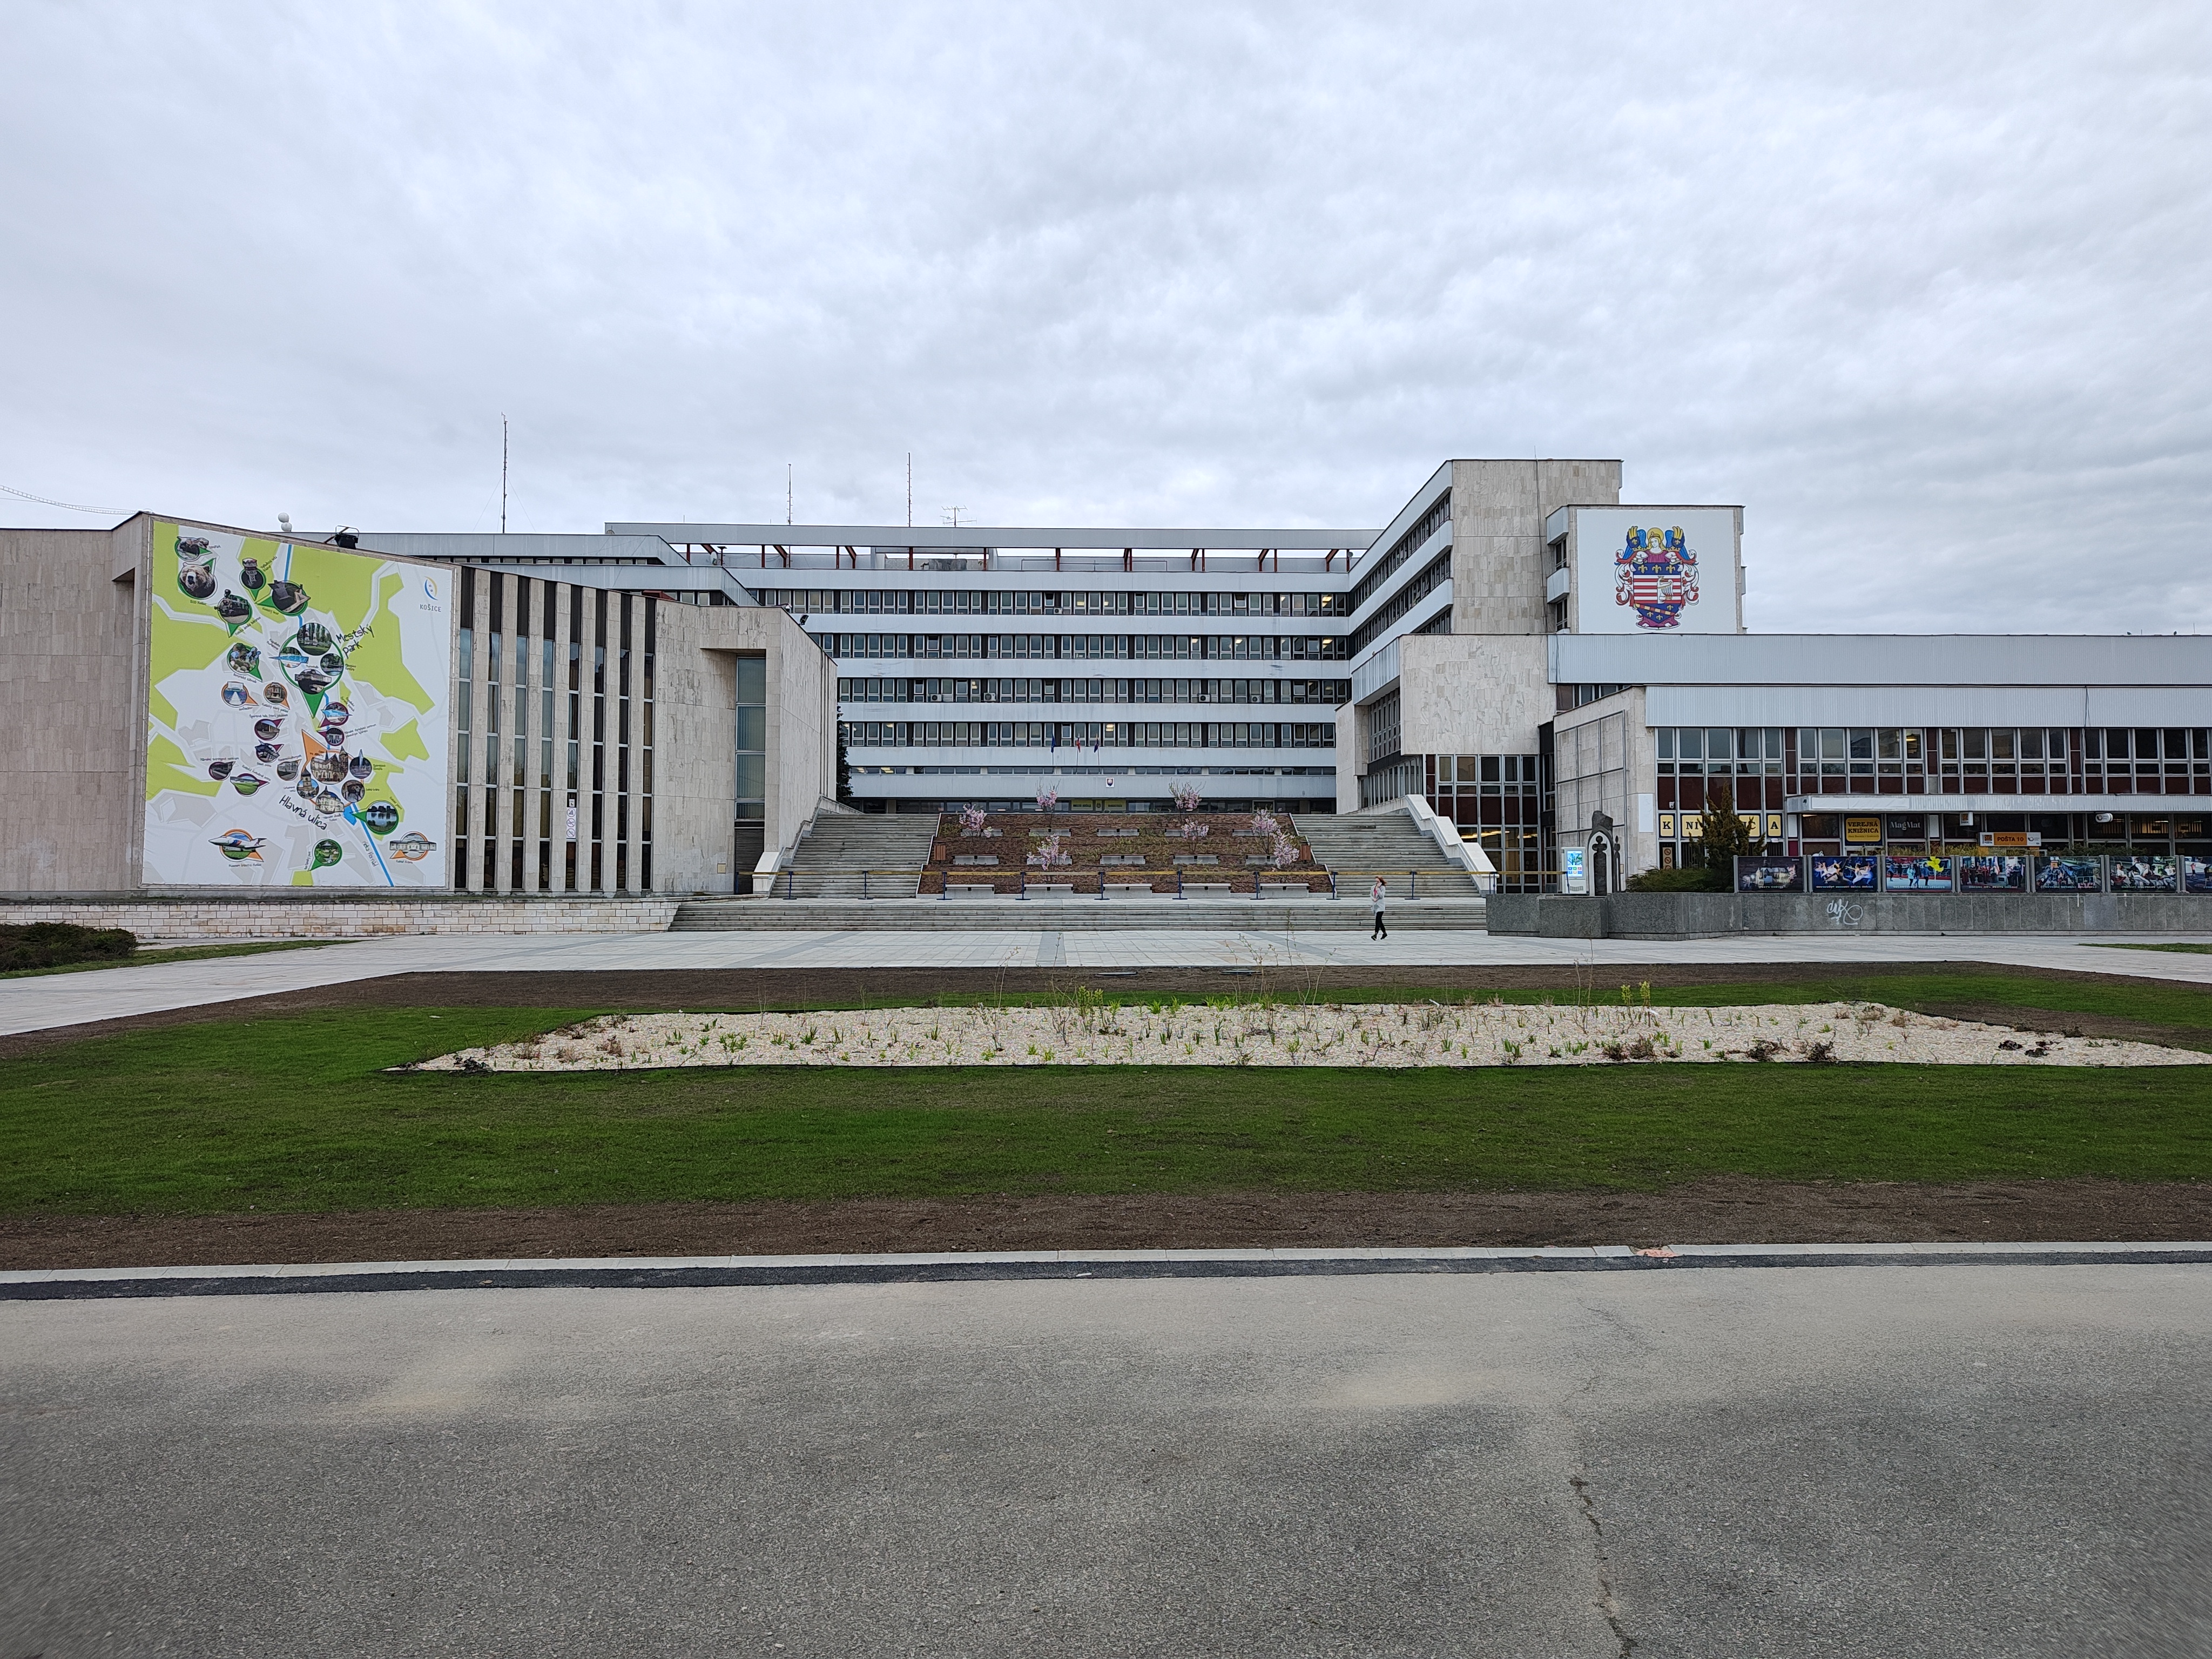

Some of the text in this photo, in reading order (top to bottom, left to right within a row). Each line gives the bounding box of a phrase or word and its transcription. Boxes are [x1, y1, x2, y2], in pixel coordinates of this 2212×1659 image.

[420, 604, 441, 612] KOŠICE
[335, 624, 375, 644] Mestský
[342, 639, 363, 659] park
[279, 794, 308, 818] Hlavná
[308, 814, 327, 830] ulica
[1890, 821, 1921, 831] MagMat
